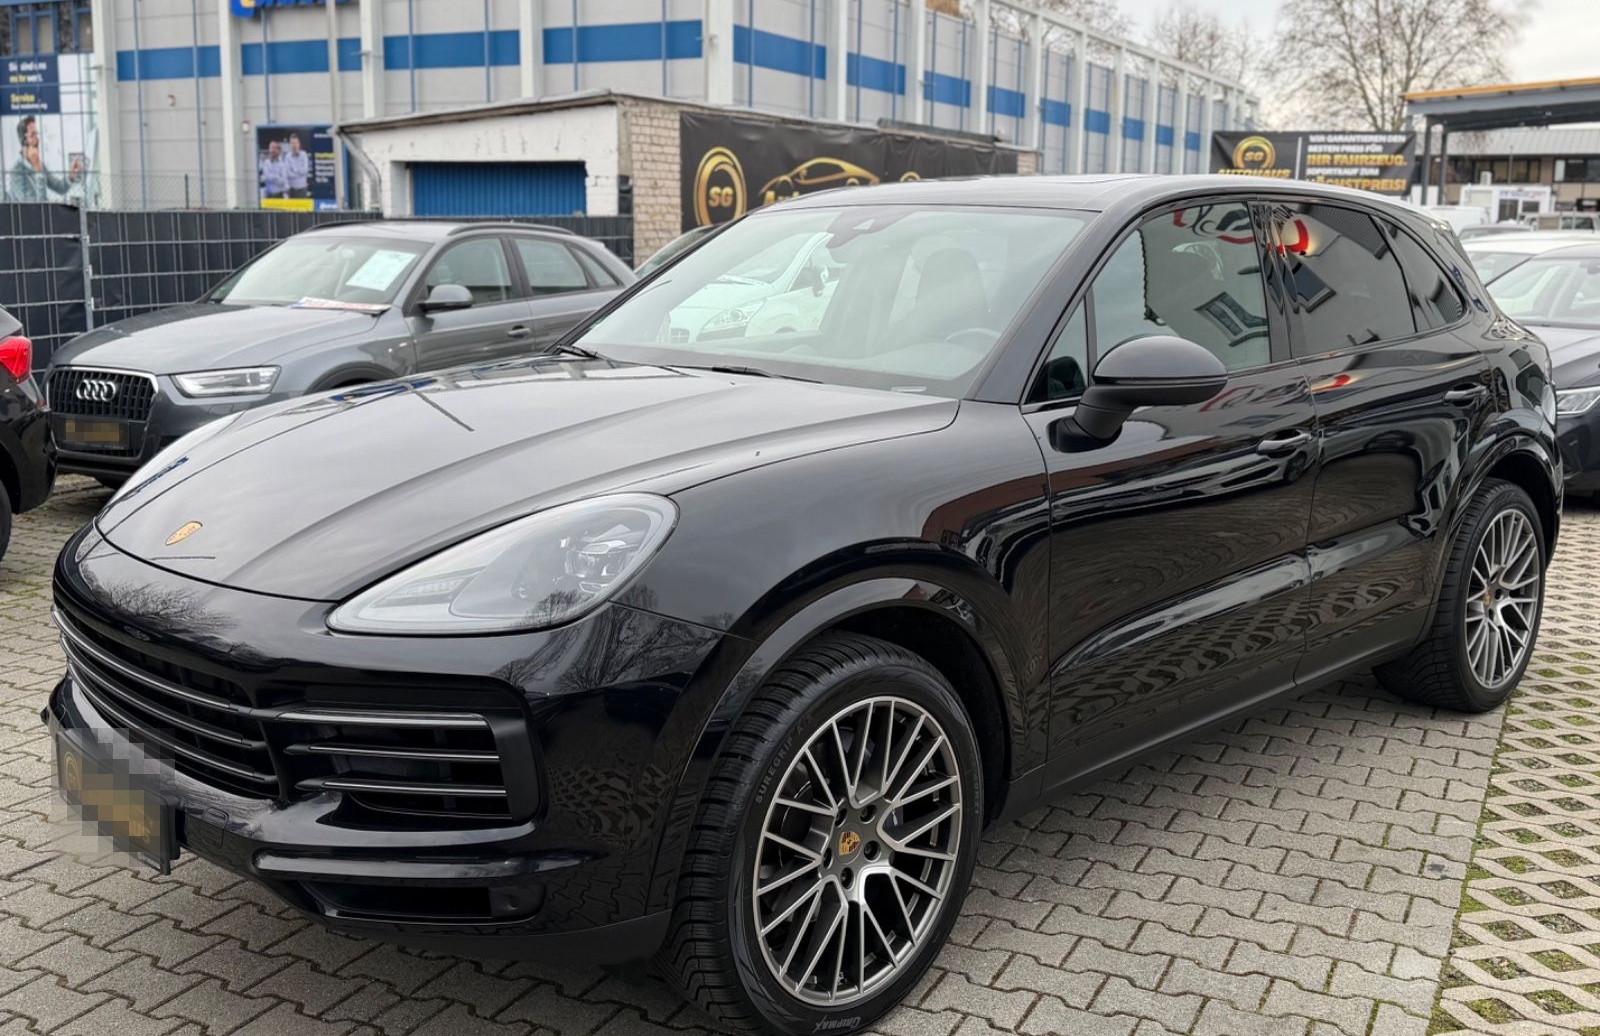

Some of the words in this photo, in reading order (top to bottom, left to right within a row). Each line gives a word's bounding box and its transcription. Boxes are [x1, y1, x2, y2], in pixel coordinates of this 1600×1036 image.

[1309, 134, 1326, 143] WIR
[1326, 134, 1386, 143] GARANTIEREN
[1387, 134, 1406, 143] DEN
[1307, 144, 1339, 153] BESTEN
[1340, 144, 1364, 153] PREIS
[1365, 142, 1384, 153] FÜR
[1244, 151, 1265, 161] SG
[1306, 154, 1332, 166] IHR
[1333, 154, 1408, 166] FAHRZEUG.
[1360, 167, 1380, 176] ZUM
[1306, 174, 1407, 191] ÖCHSTPREIS!
[709, 186, 733, 207] SG
[755, 737, 793, 804] SUREGRIP
